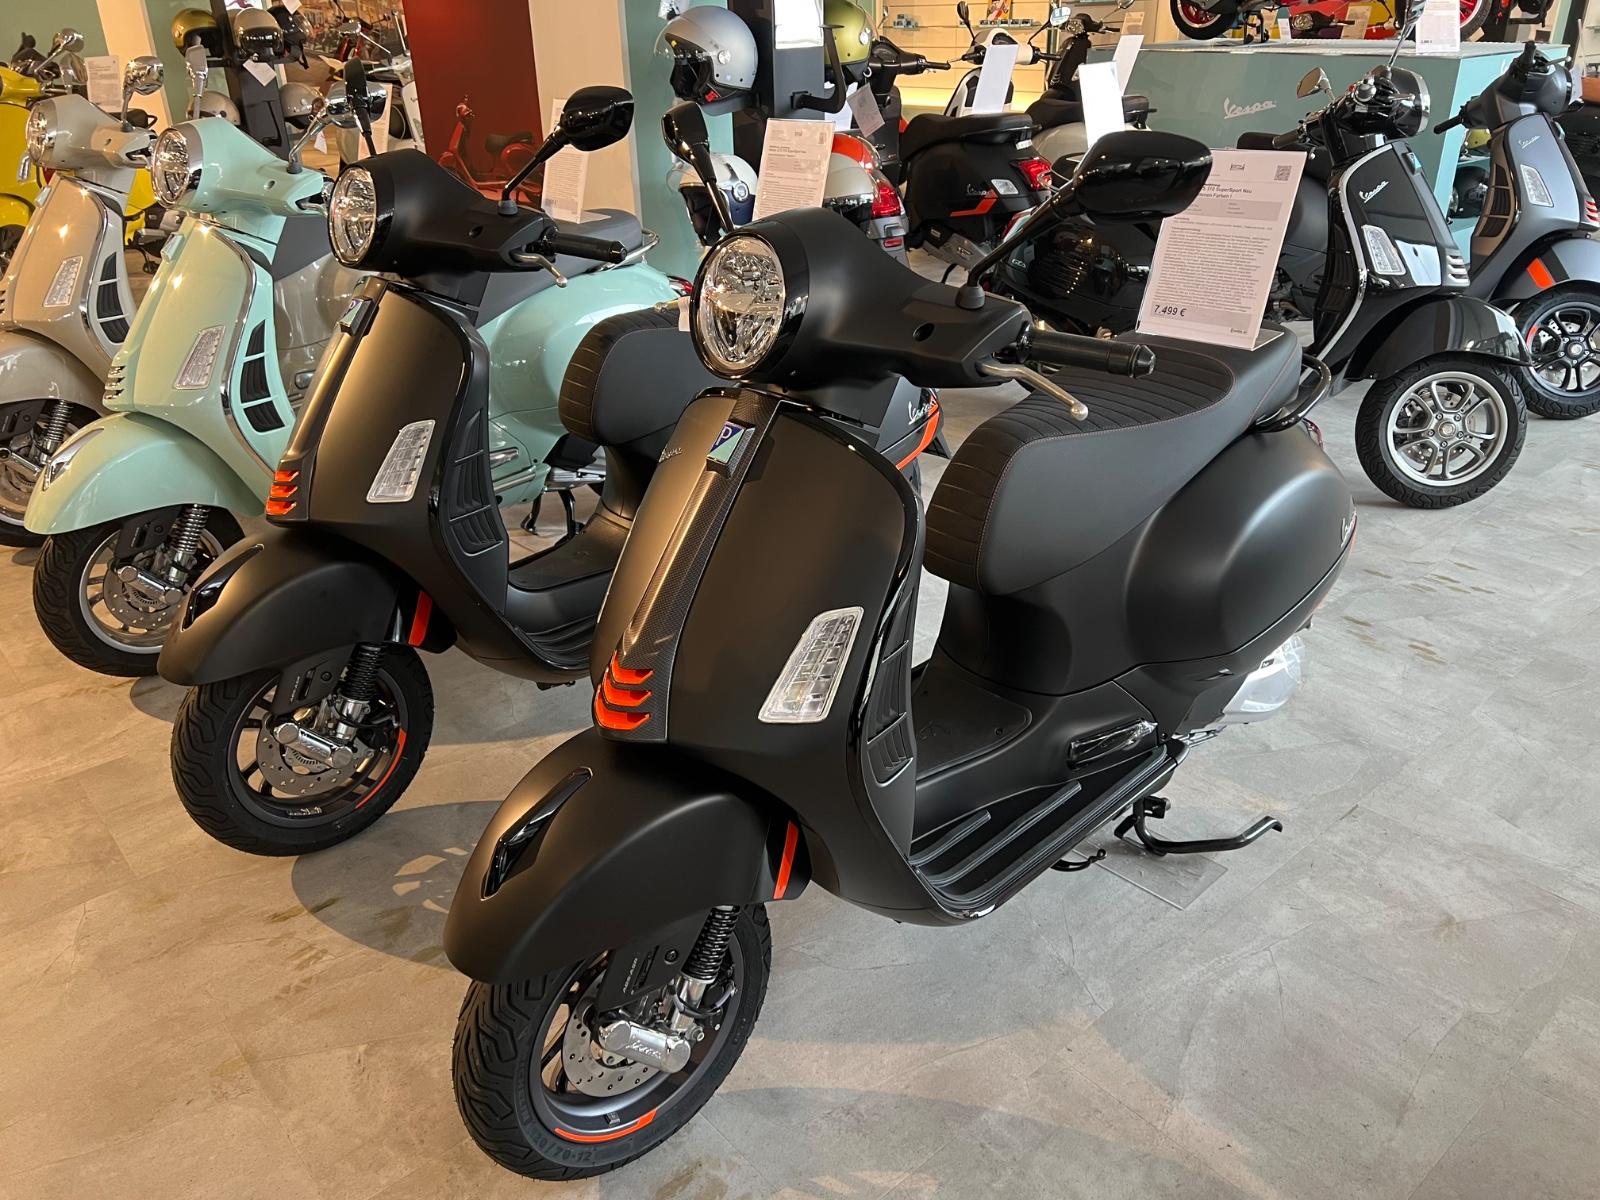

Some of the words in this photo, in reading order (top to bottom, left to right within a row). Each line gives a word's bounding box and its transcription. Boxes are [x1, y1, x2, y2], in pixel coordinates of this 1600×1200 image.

[1223, 97, 1277, 119] Vespa
[1358, 180, 1390, 204] Vespa
[1154, 304, 1178, 316] 7.499
[1180, 307, 1187, 317] €
